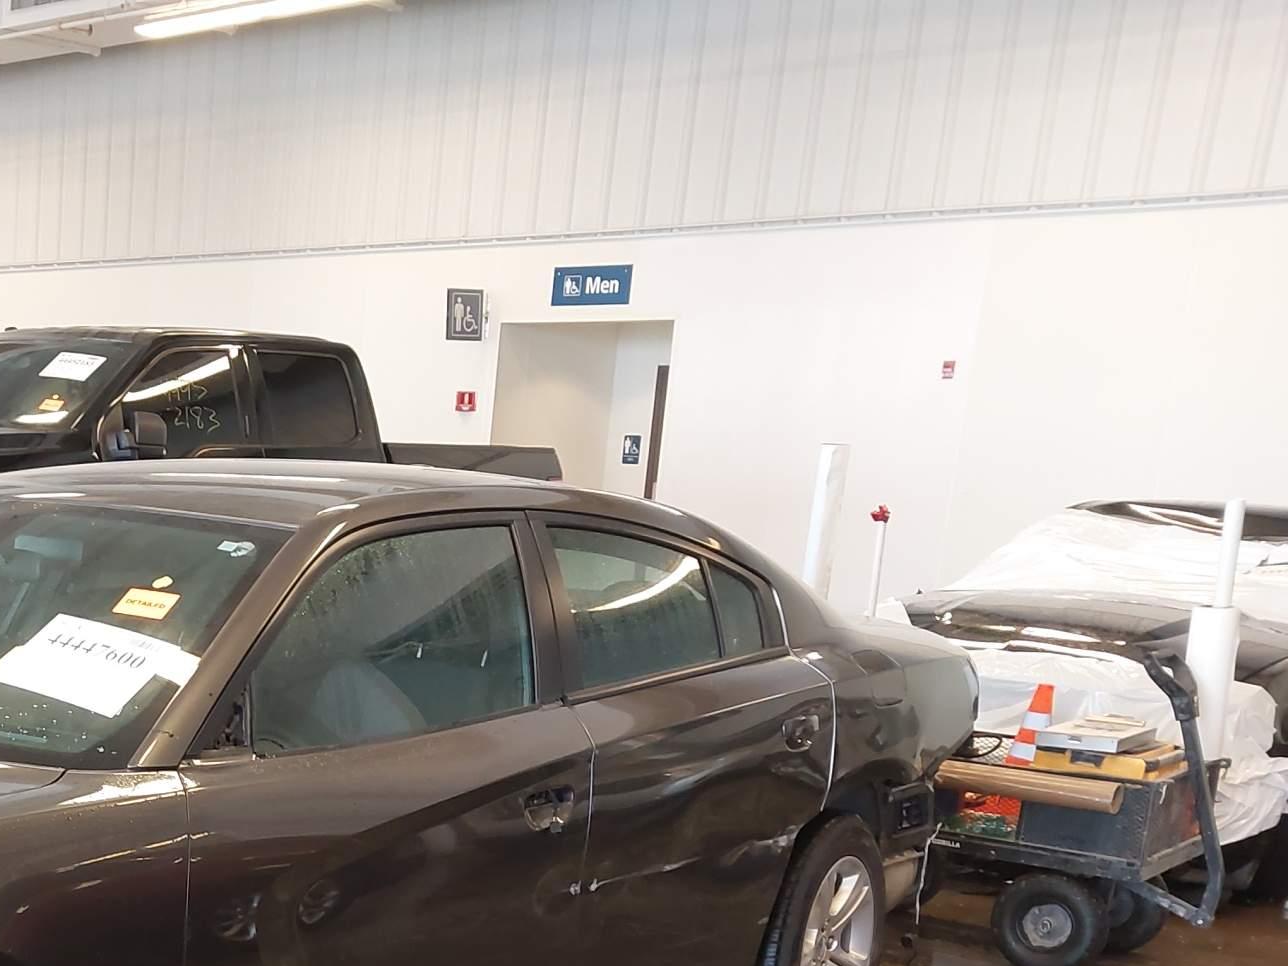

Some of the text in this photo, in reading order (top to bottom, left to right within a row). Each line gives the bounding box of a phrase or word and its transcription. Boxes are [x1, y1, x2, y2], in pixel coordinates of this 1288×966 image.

[585, 276, 619, 294] Men
[174, 406, 221, 433] 2183
[125, 598, 166, 610] DETAILED
[47, 633, 147, 669] 44447600
